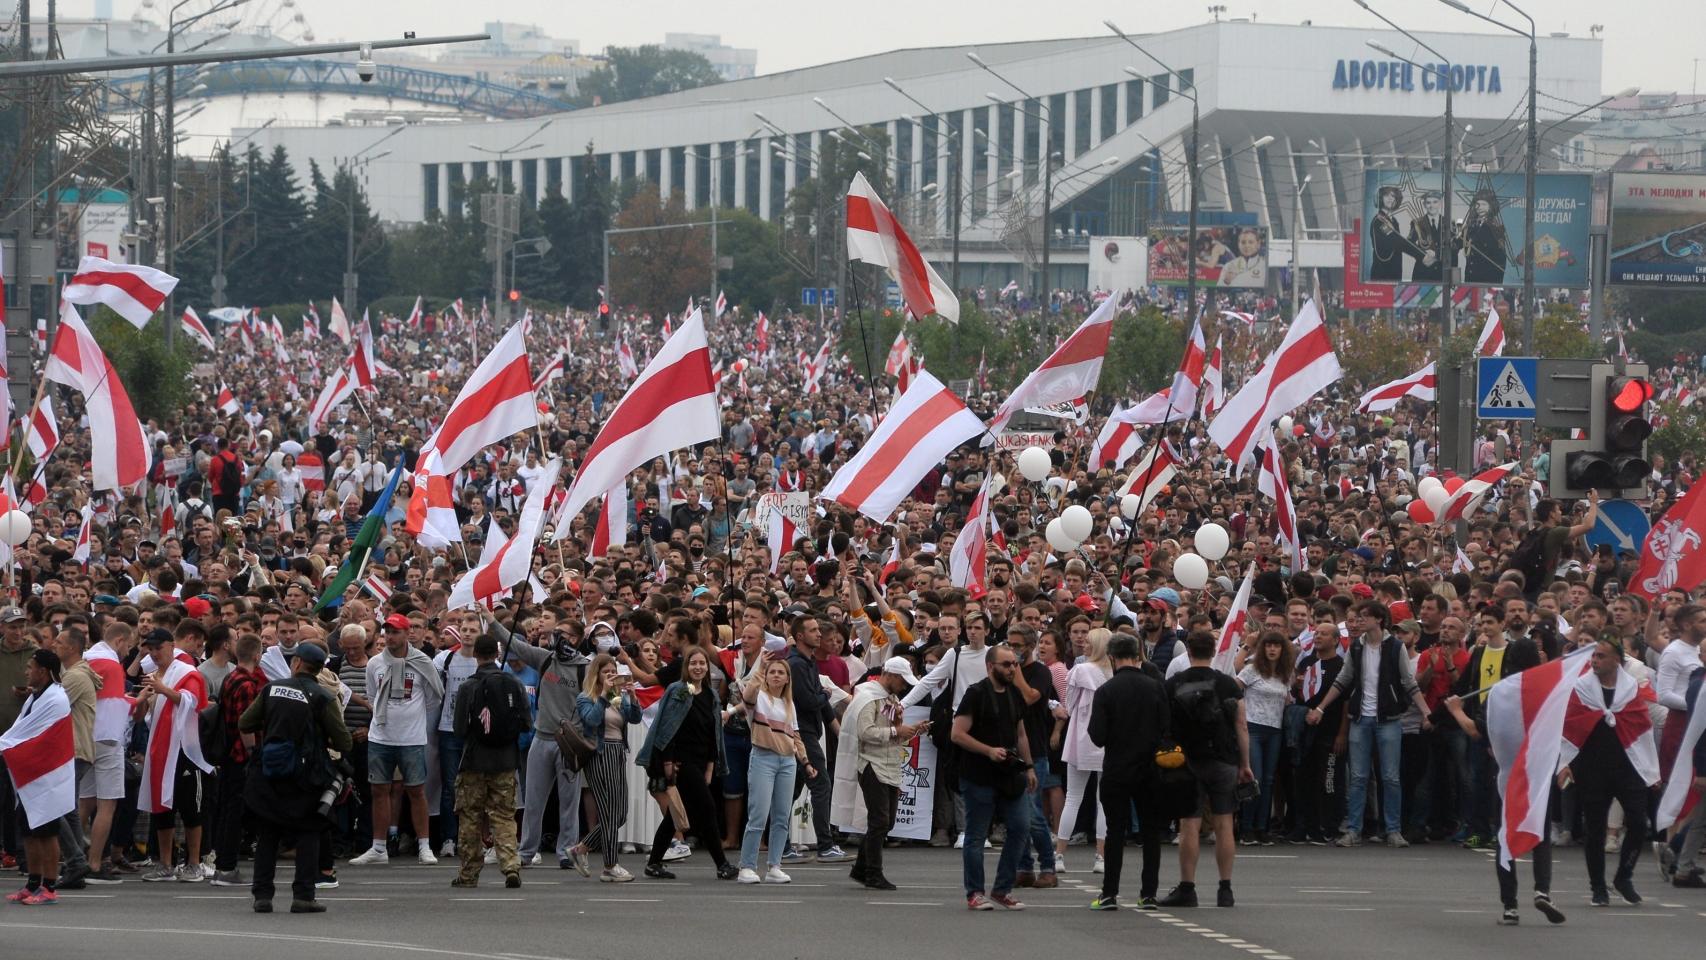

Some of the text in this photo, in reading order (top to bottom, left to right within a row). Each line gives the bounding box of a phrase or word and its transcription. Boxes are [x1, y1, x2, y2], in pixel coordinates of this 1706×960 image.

[1332, 59, 1502, 94] ДВОРЕЦ СПОРТА
[1628, 187, 1645, 197] ЭТА
[1538, 198, 1577, 210] ДРУЖБА
[1622, 273, 1635, 281] ОНИ
[1637, 273, 1663, 281] МЕШАЮТ
[1666, 274, 1700, 283] УСЛЫШАТЬ
[274, 687, 306, 700] PRESS
